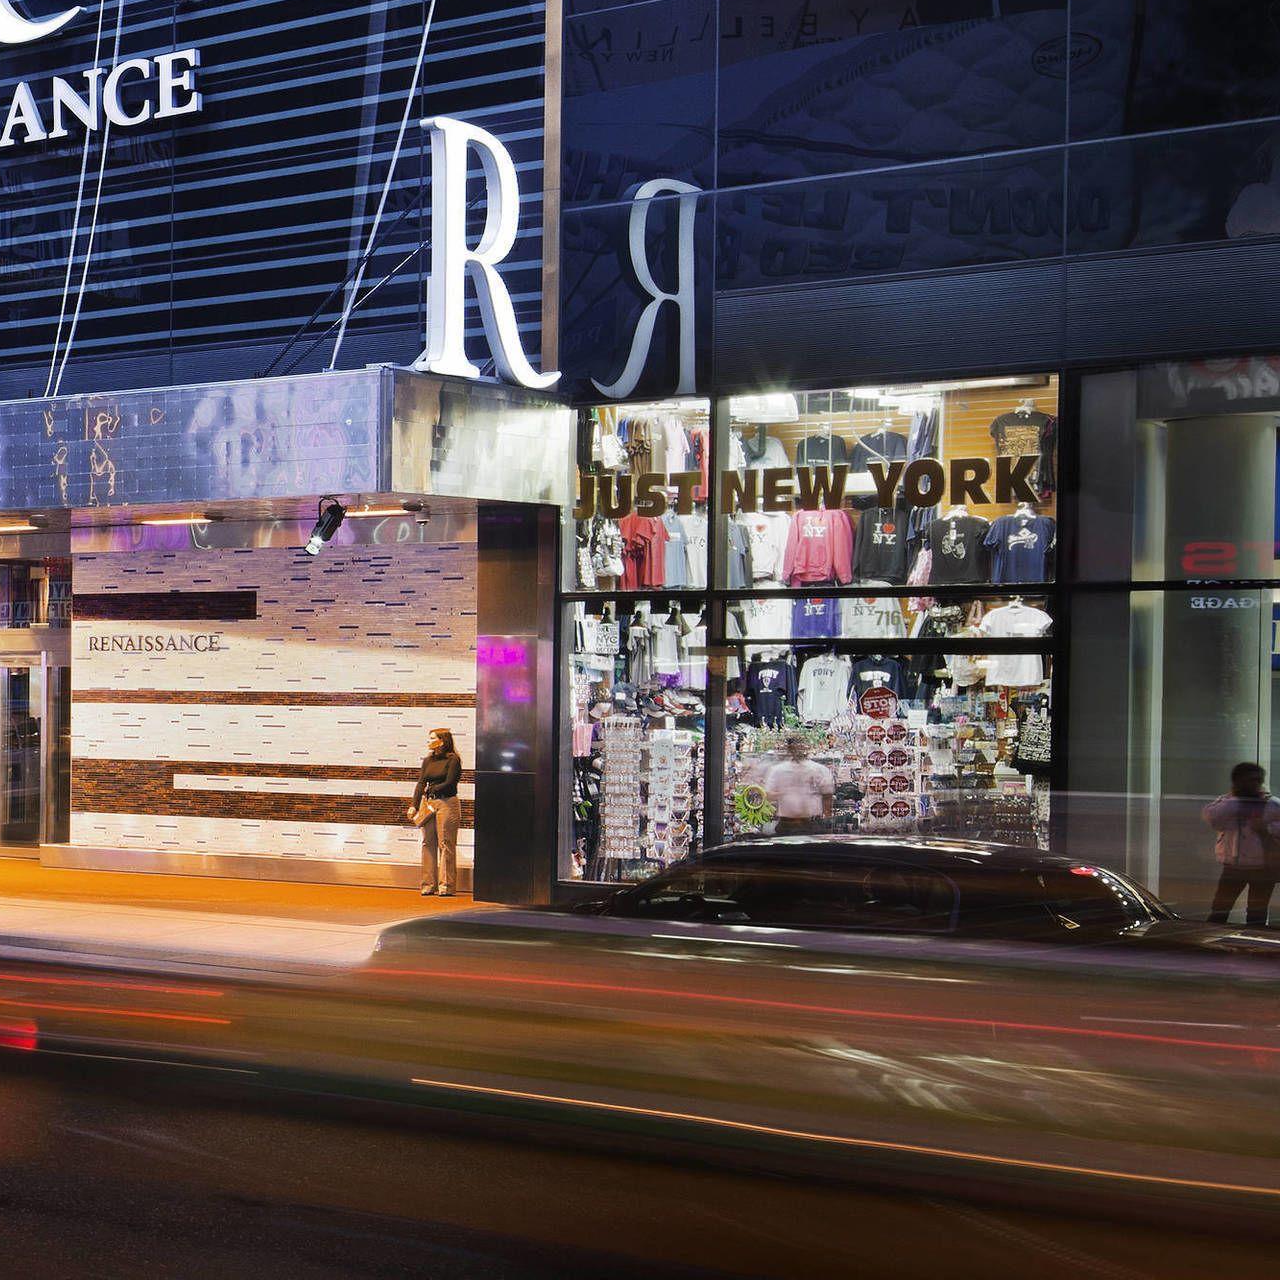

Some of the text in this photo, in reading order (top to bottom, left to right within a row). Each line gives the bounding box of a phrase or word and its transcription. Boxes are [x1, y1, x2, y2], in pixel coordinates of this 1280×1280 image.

[414, 115, 562, 388] R
[572, 453, 1042, 520] JUST NEW YORK
[871, 532, 897, 545] NY
[88, 634, 221, 654] RENAISSANCE
